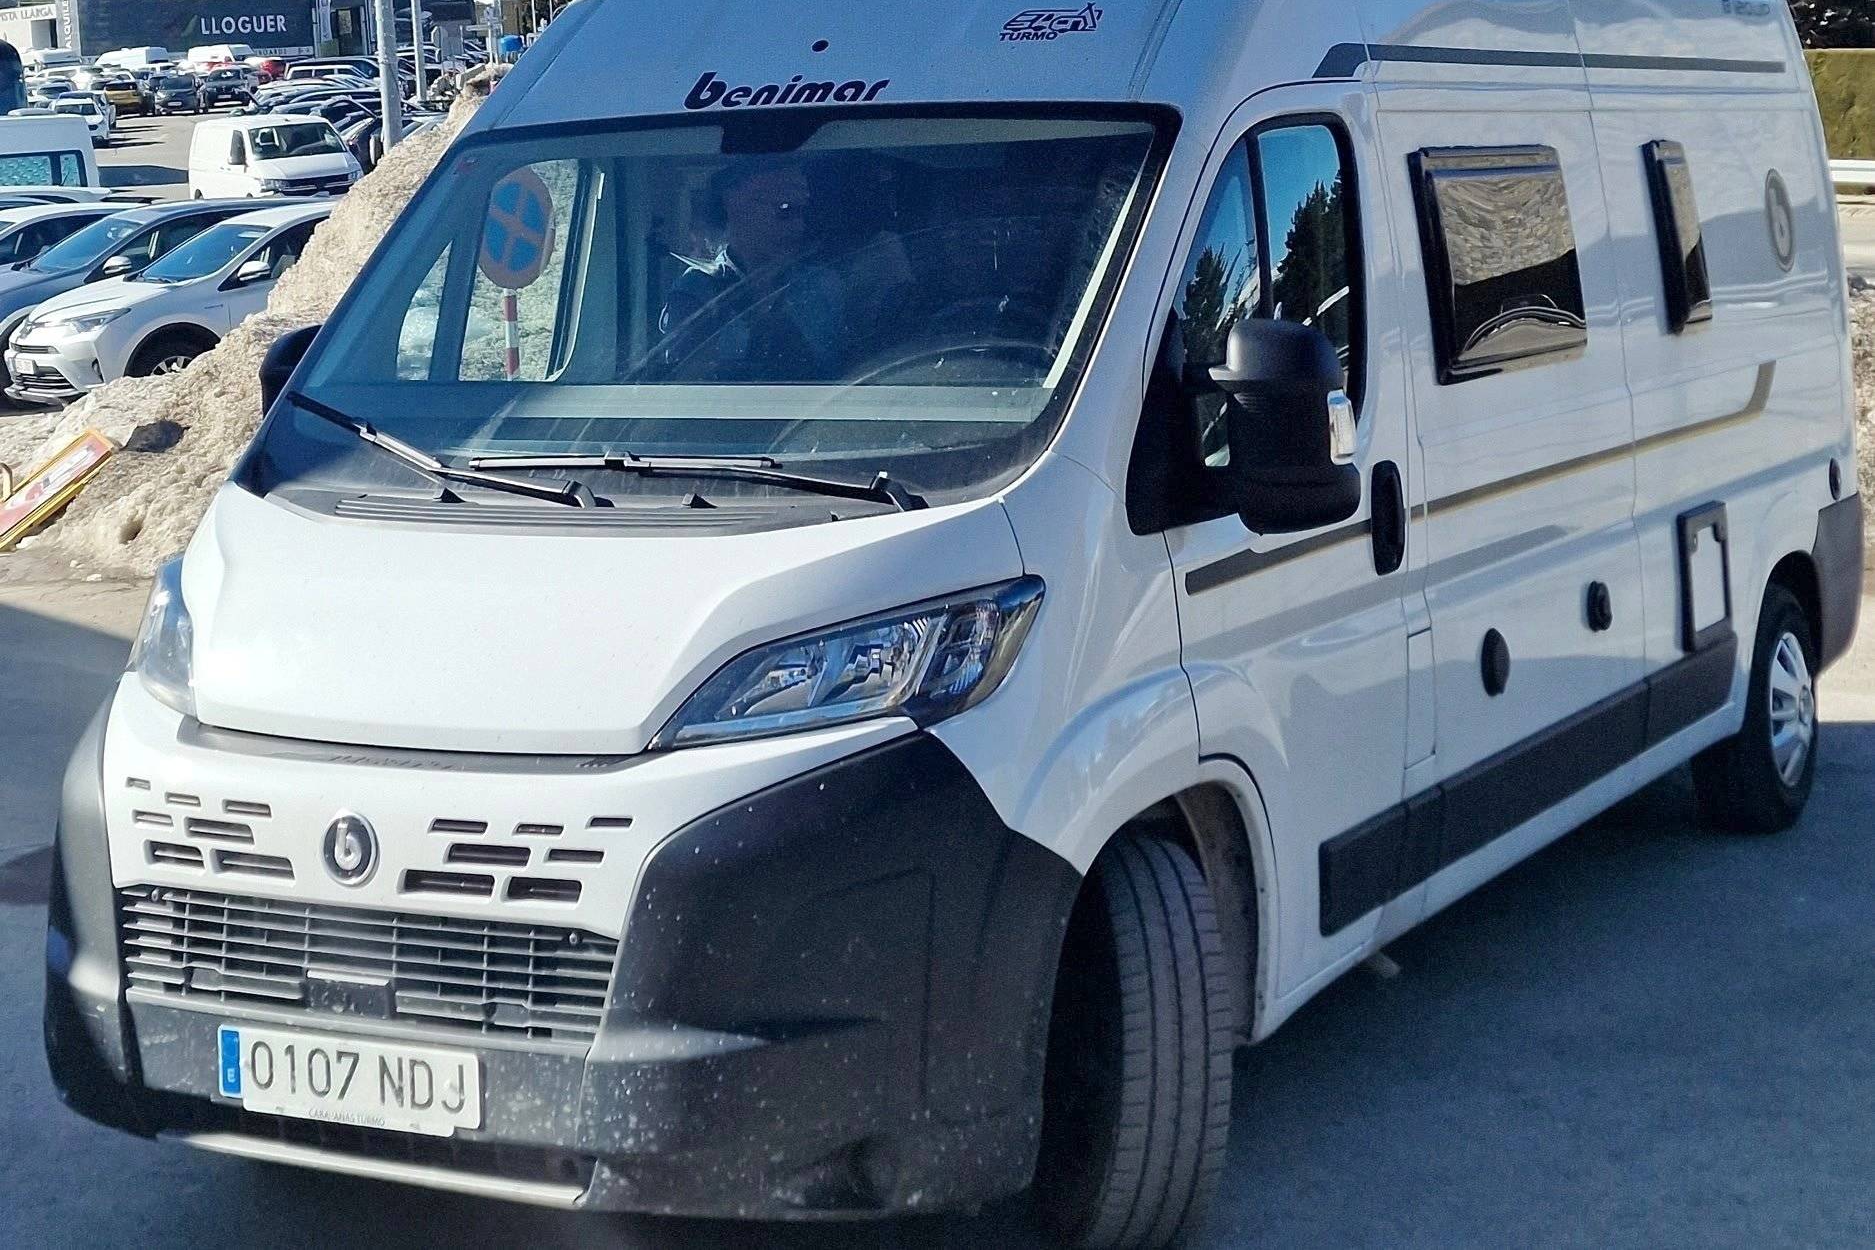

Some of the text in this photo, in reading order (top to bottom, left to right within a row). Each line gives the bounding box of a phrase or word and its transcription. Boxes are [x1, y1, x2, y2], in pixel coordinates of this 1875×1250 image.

[0, 12, 17, 21] ISTA
[200, 14, 287, 35] LLOGUER
[999, 31, 1058, 42] TURMO
[683, 71, 890, 110] benimar
[250, 1040, 466, 1114] 0107 NDJ
